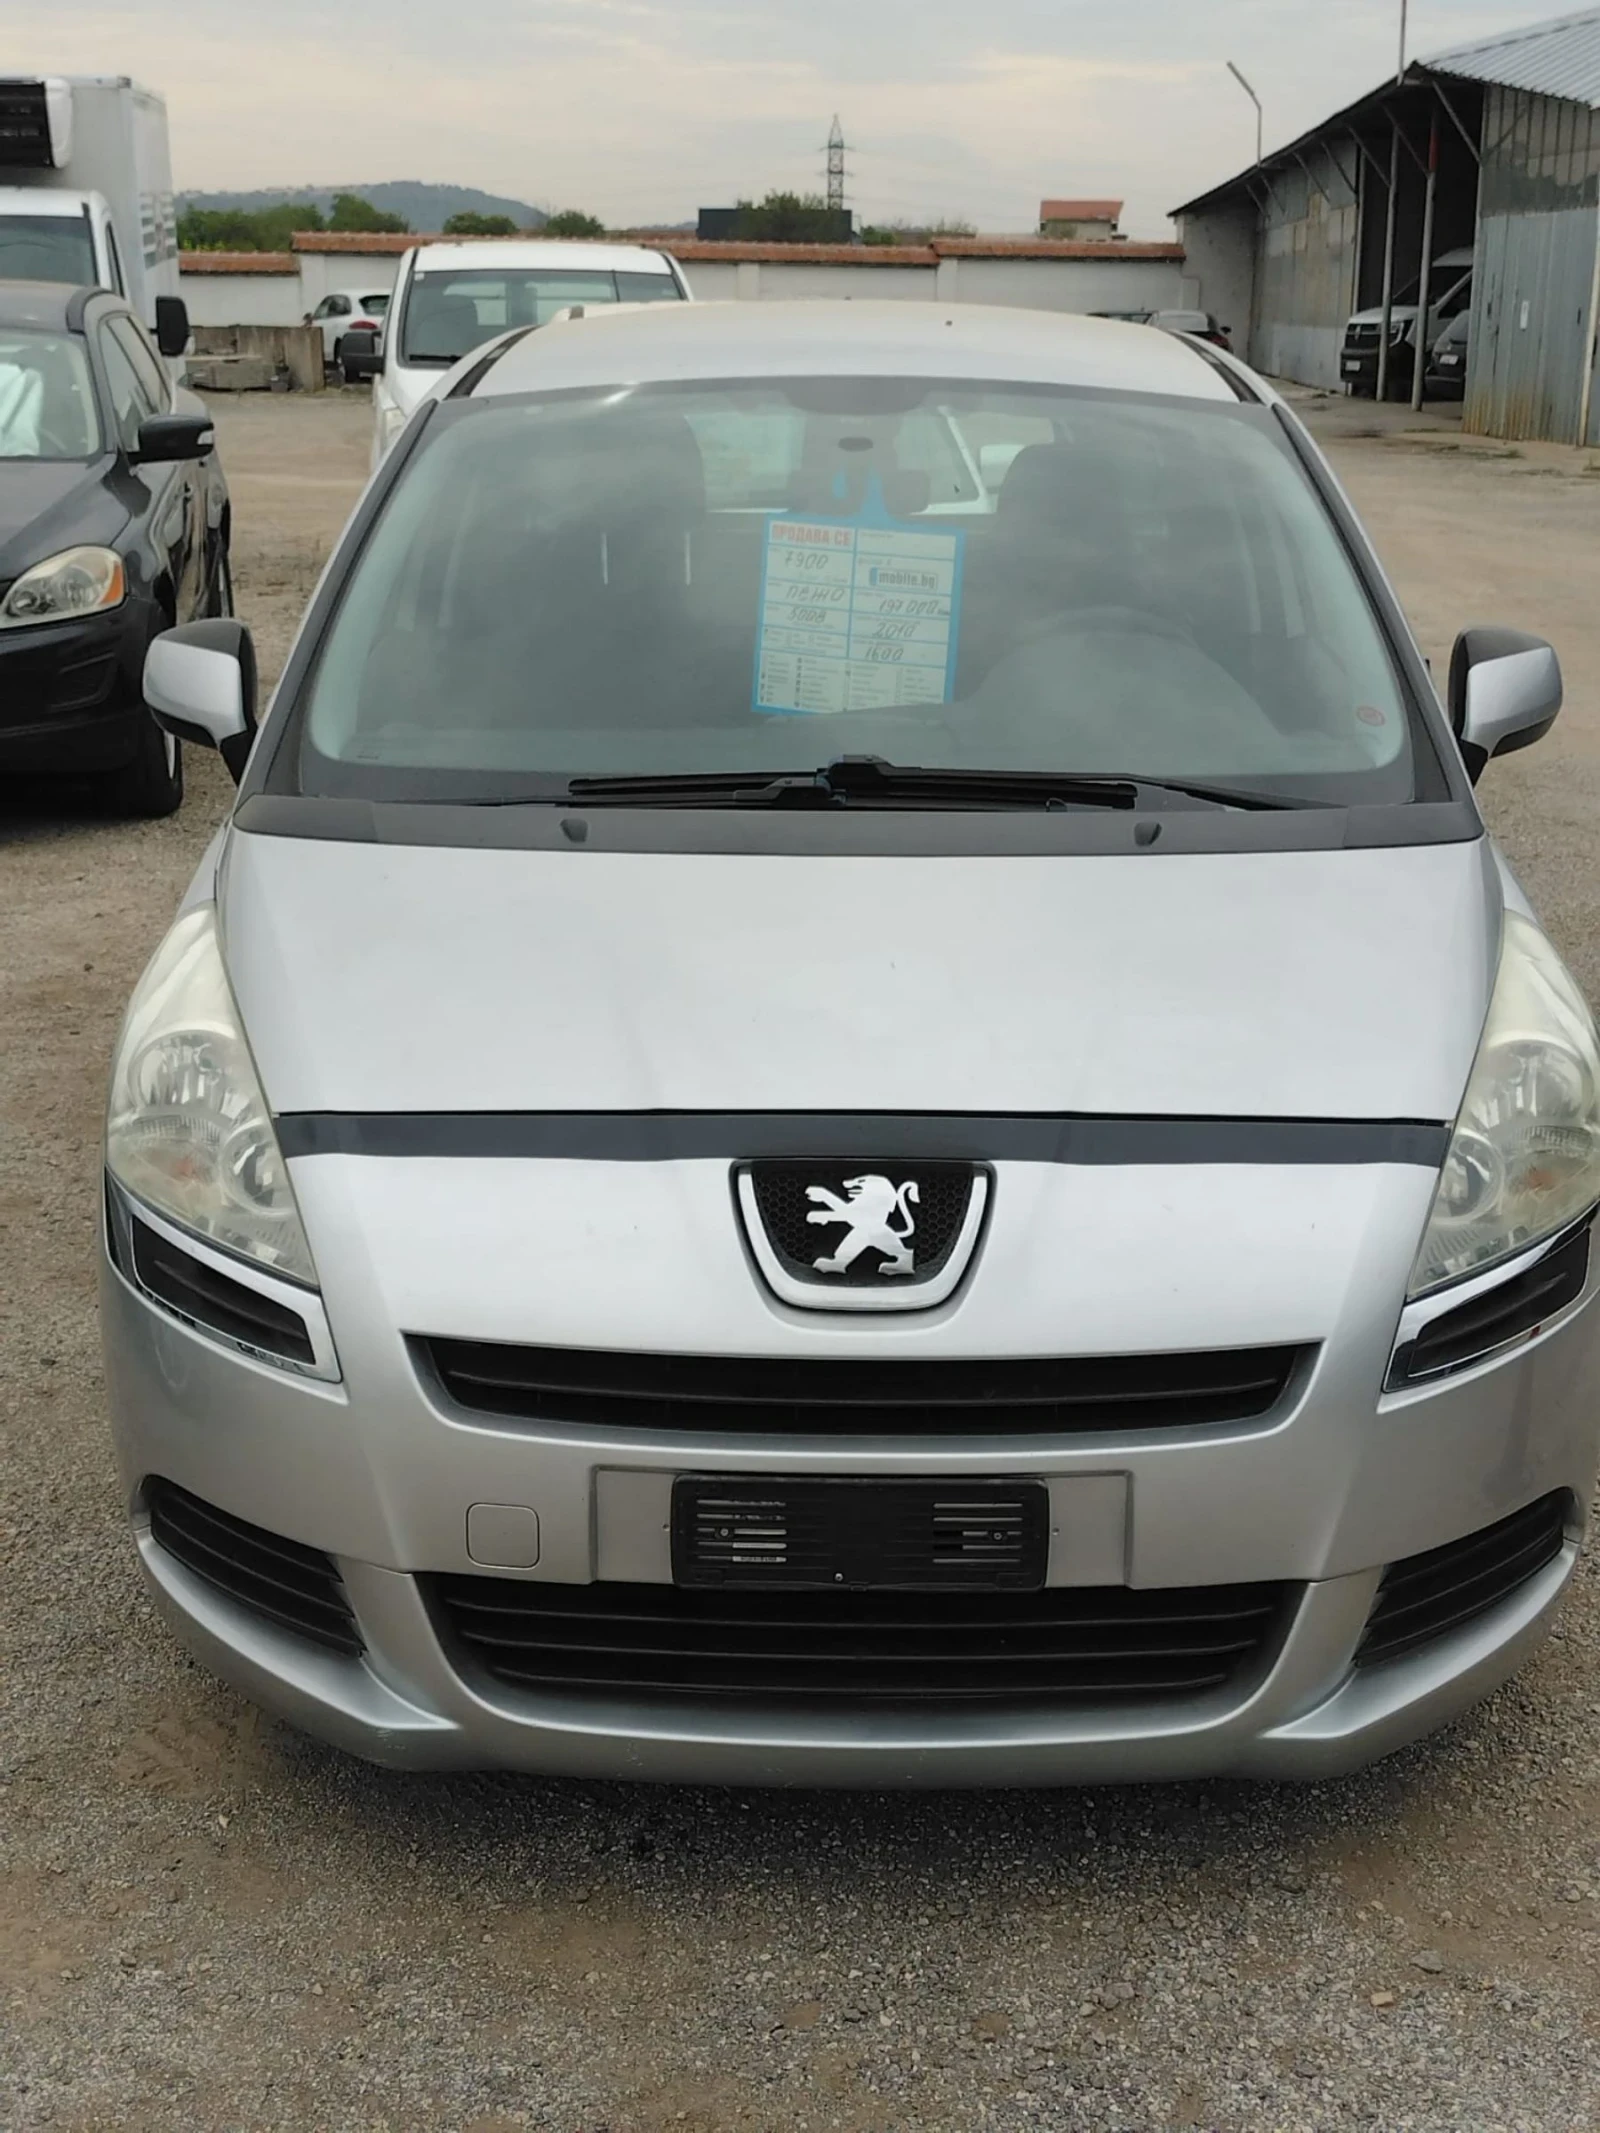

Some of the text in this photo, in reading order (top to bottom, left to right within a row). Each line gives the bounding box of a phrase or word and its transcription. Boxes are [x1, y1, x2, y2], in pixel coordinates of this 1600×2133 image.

[771, 524, 851, 547] ПРОДАВА СЕ
[785, 550, 829, 571] 7900
[878, 569, 936, 589] mobile.bg
